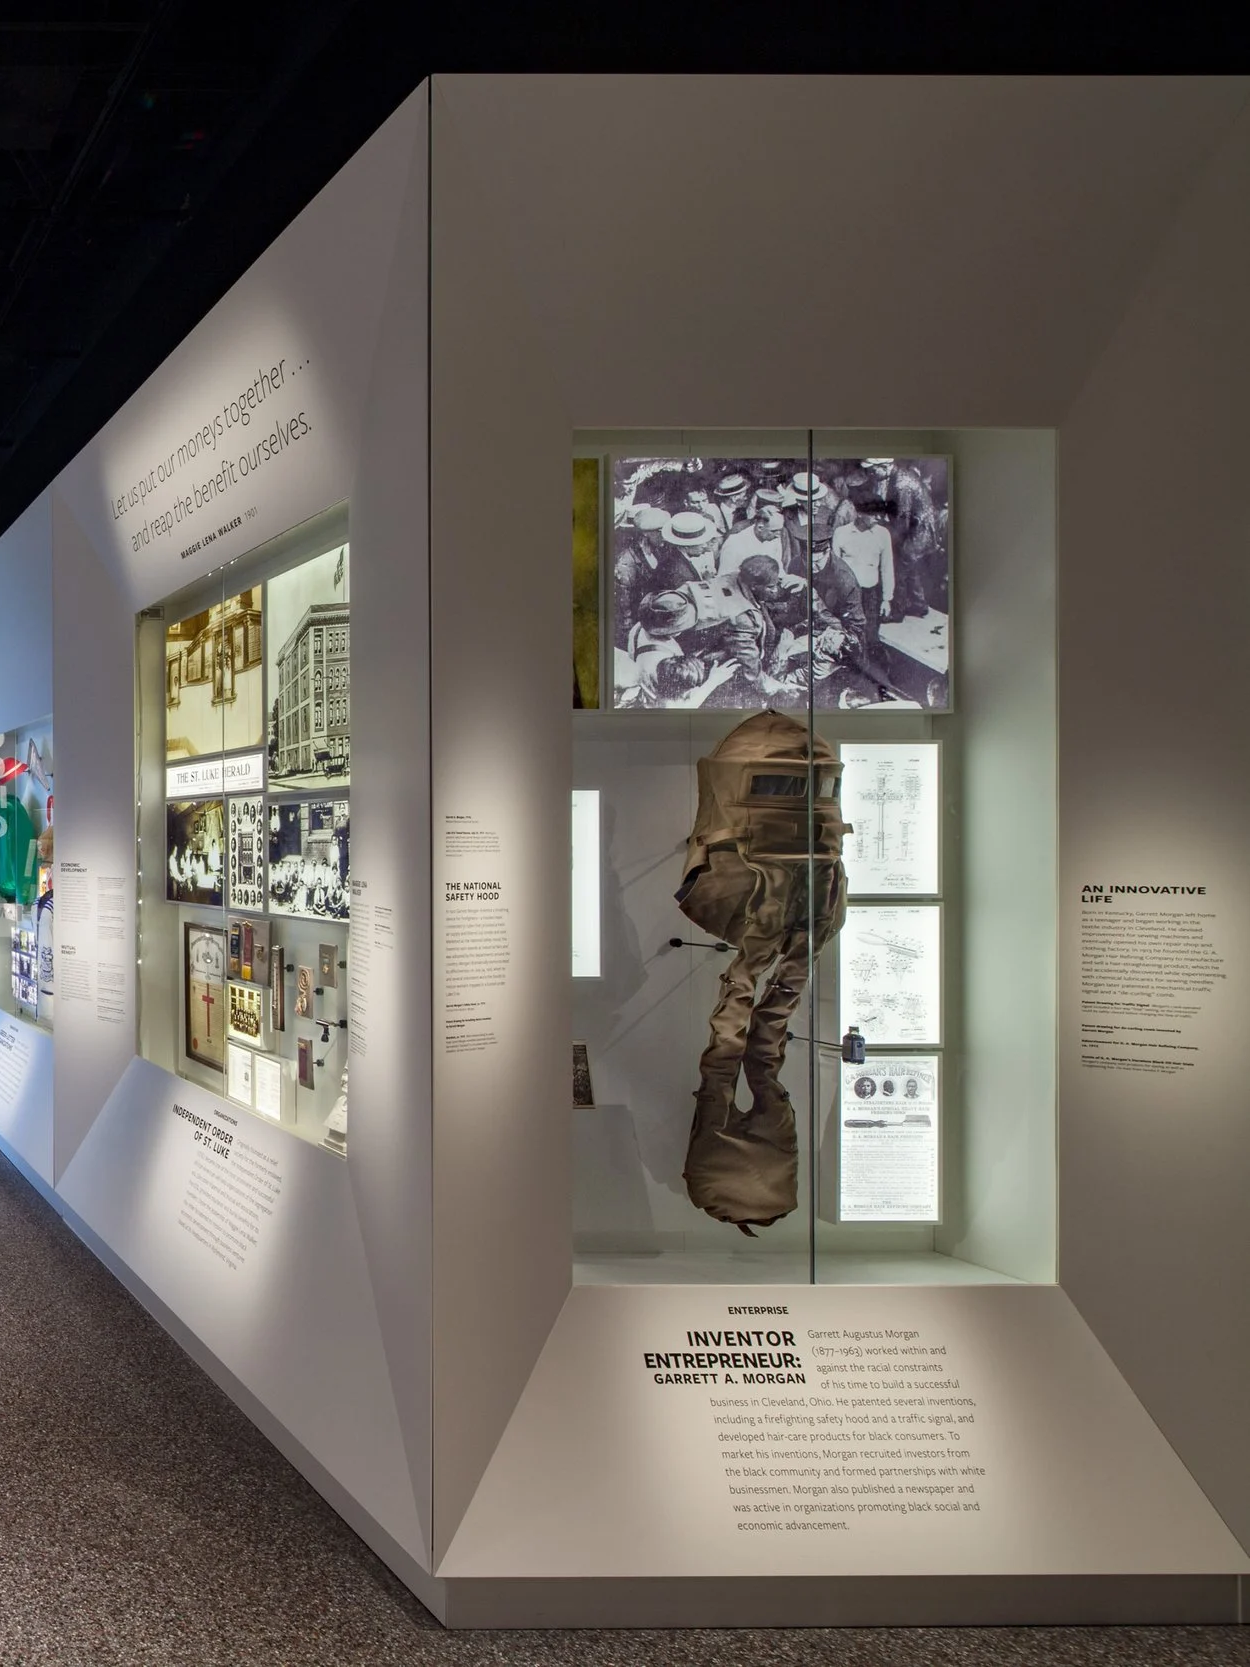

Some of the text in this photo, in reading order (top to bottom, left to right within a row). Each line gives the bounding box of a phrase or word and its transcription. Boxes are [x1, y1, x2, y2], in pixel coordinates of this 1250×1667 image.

[111, 359, 286, 520] Let us put our moneys together
[131, 412, 312, 552] and reap the benefit ourselves.
[181, 506, 258, 560] MAGGIE LENA WALKER 1901
[177, 762, 251, 785] THE ST. LUKE HERALD
[446, 881, 502, 890] THE NATIONAL
[1082, 885, 1207, 895] AN INNOVATIVE
[445, 892, 499, 901] SAFETY HOOD
[1082, 895, 1113, 903] LIFE
[172, 1103, 234, 1146] INDEPENDENT ORDER
[214, 1109, 238, 1127] ORGANIZATIONS
[194, 1130, 230, 1160] OF ST. LUKE
[728, 1306, 789, 1315] ENTERPRISE
[687, 1331, 796, 1347] INVENTOR
[807, 1330, 919, 1341] Garrett Augustus Morgan
[812, 1345, 946, 1358] (1877–1963) worked within and
[644, 1353, 802, 1369] ENTREPRENEUR:
[816, 1363, 943, 1375] against the racial constraints
[654, 1373, 806, 1385] GARRETT A. MORGAN
[821, 1380, 830, 1389] of
[832, 1380, 846, 1389] his
[847, 1380, 868, 1389] time
[870, 1381, 880, 1389] to
[882, 1380, 904, 1389] build
[914, 1379, 960, 1389] successful
[710, 1396, 976, 1408] business in Cleveland, Ohio. He patented several inventions,
[714, 1414, 756, 1426] including
[764, 1414, 815, 1426] firefighting
[816, 1414, 843, 1426] safety
[845, 1414, 871, 1424] hood
[871, 1414, 888, 1424] and
[898, 1413, 926, 1423] traffic
[928, 1414, 956, 1426] signal,
[958, 1414, 974, 1423] and
[718, 1432, 765, 1444] developed
[766, 1432, 808, 1441] hair-care
[810, 1432, 851, 1444] products
[852, 1430, 866, 1440] for
[868, 1432, 893, 1440] black
[947, 1431, 960, 1440] To
